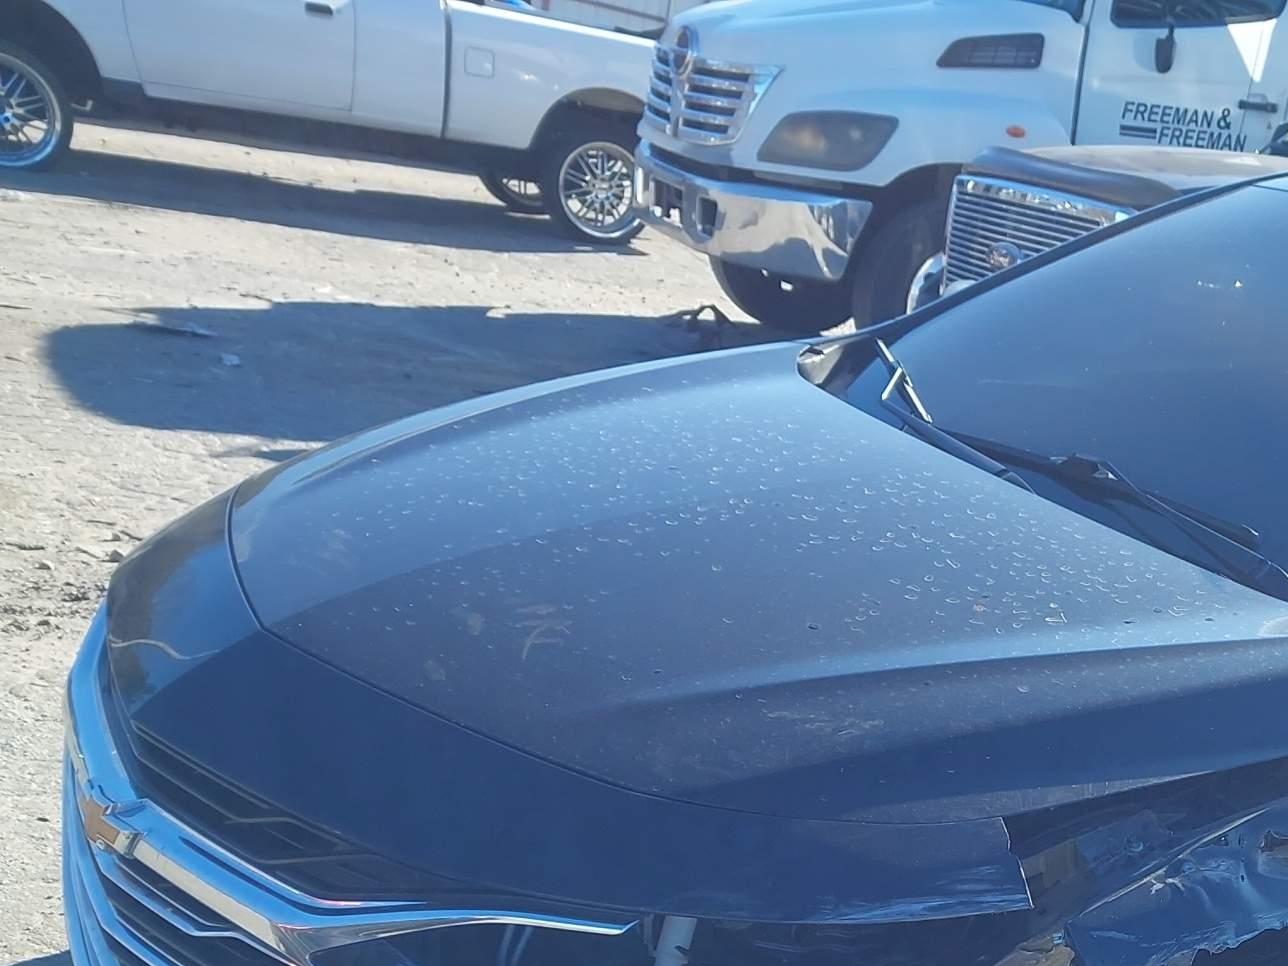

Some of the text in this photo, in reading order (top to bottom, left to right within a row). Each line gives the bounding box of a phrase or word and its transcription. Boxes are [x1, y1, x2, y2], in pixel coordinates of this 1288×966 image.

[1121, 101, 1232, 130] FREEMAN &
[1157, 126, 1247, 153] FREEMAN
